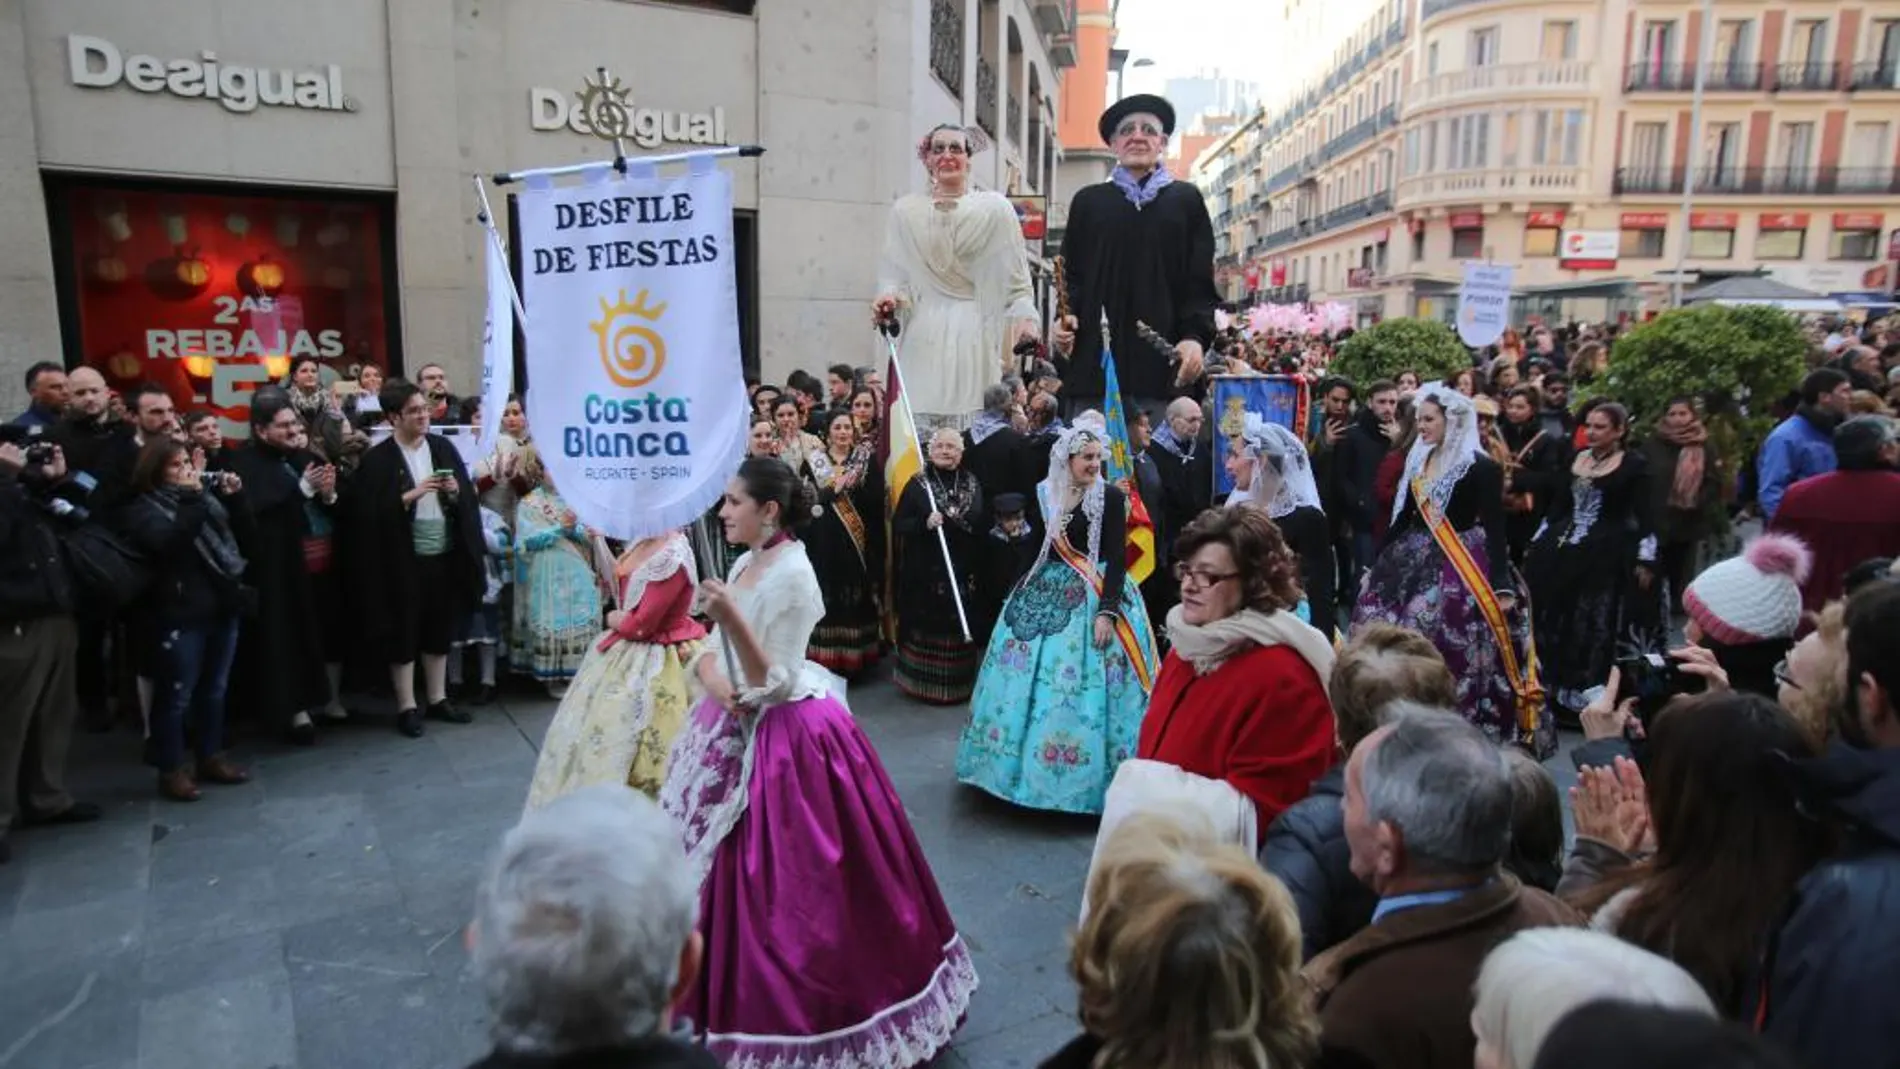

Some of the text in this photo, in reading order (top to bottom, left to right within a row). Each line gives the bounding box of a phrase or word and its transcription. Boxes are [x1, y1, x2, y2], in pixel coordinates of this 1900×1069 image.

[555, 193, 694, 230] DESFILE
[534, 235, 718, 274] DE FIESTAS
[146, 329, 344, 358] REBAJAS
[585, 392, 688, 425] Costa
[564, 426, 690, 458] Blanca
[651, 465, 691, 480] SPAIN
